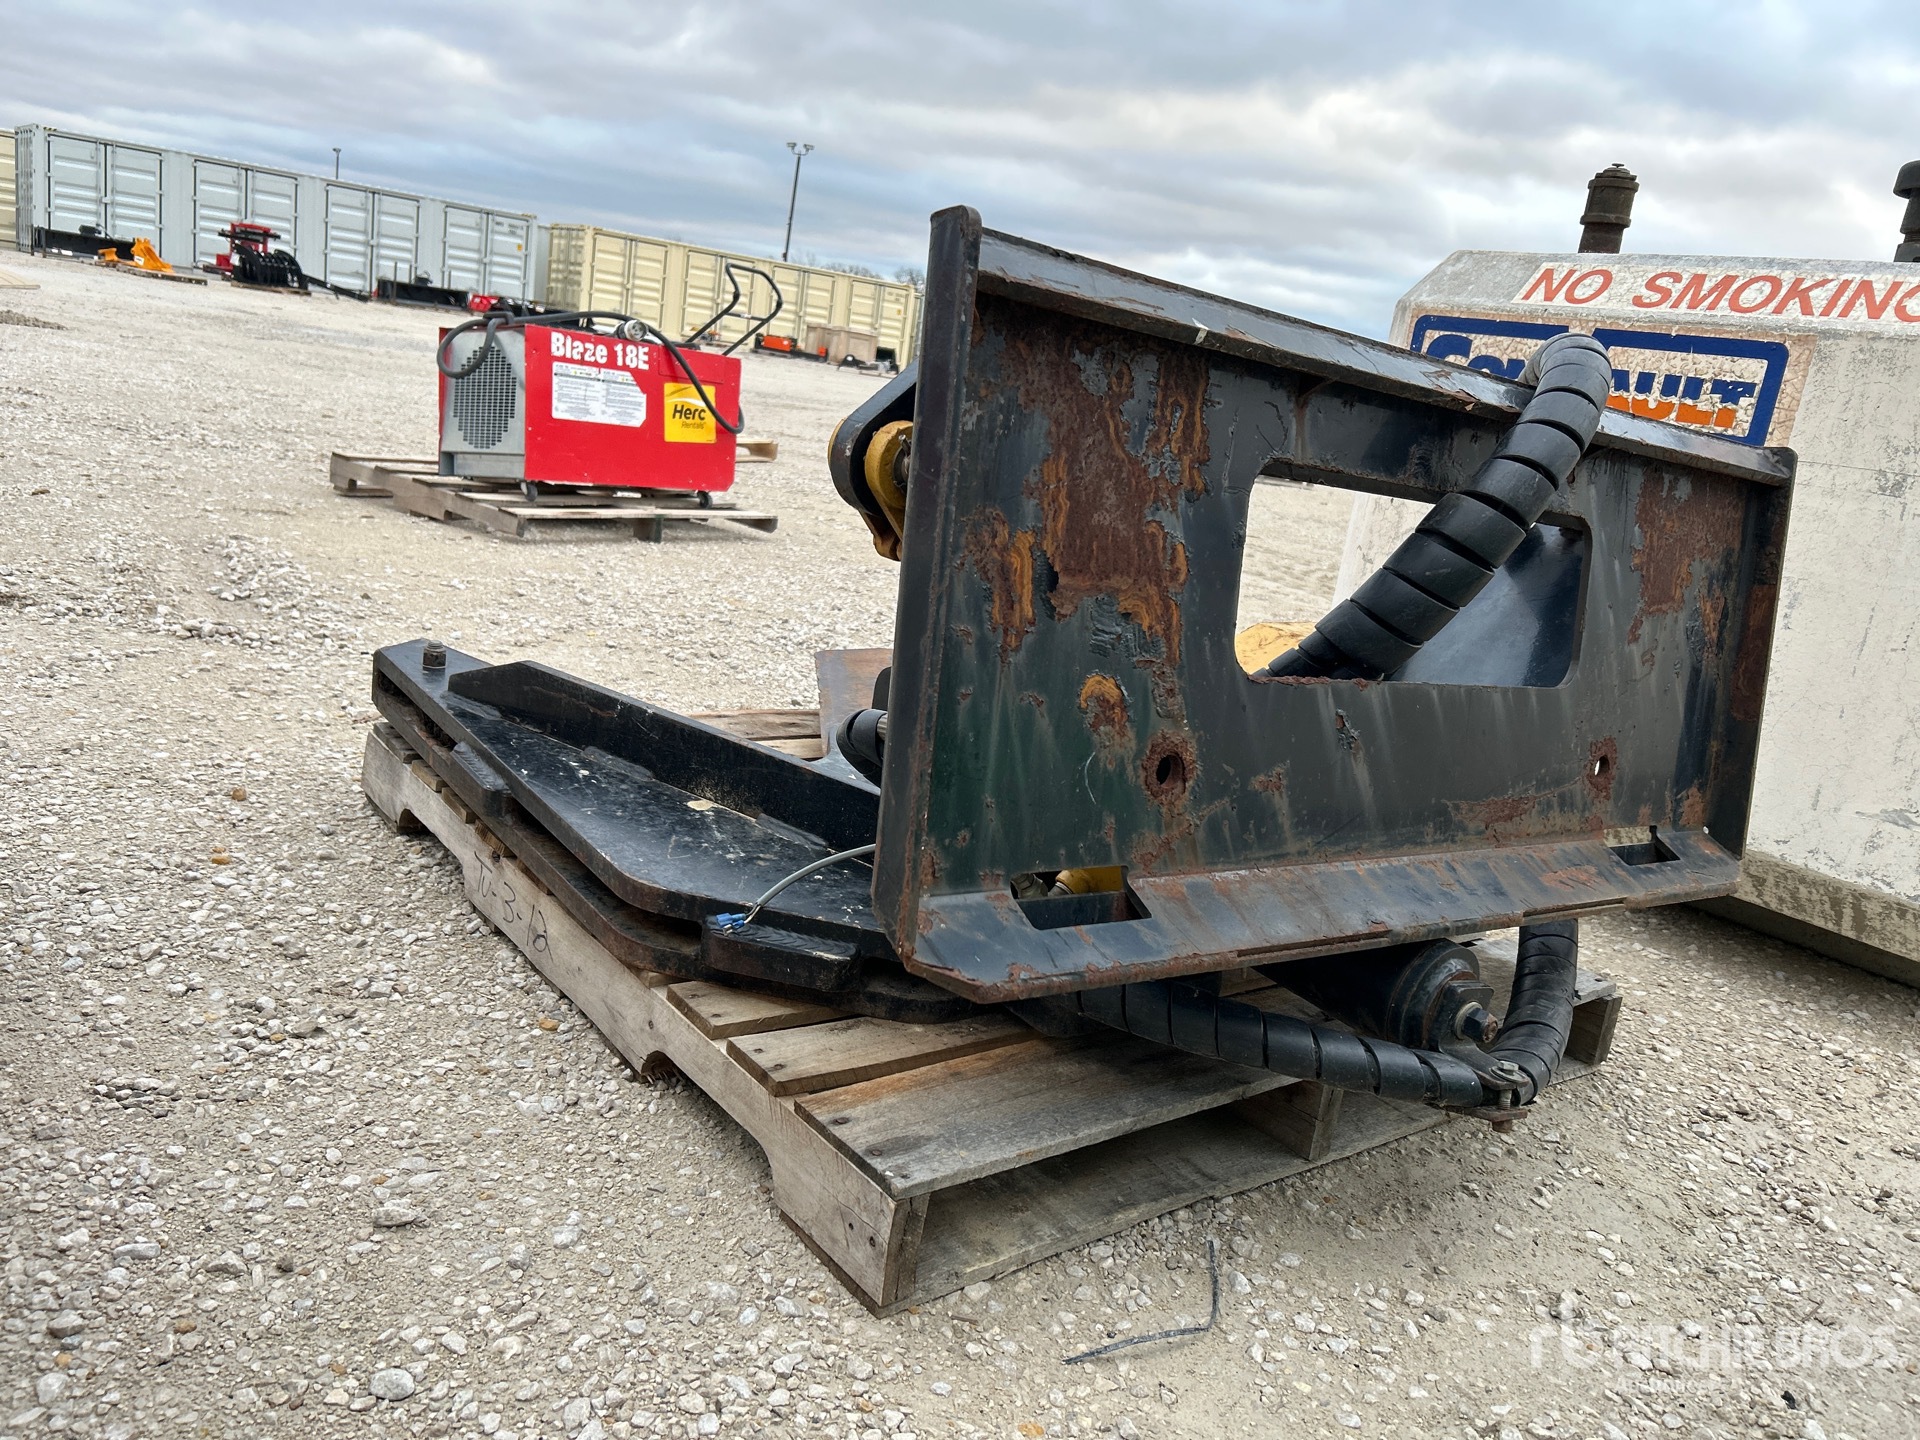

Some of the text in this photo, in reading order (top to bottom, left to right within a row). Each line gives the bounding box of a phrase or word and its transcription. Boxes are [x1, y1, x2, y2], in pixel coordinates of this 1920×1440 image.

[1521, 267, 1612, 304] NO
[551, 332, 650, 370] Blaze 18E
[672, 404, 707, 421] Herc
